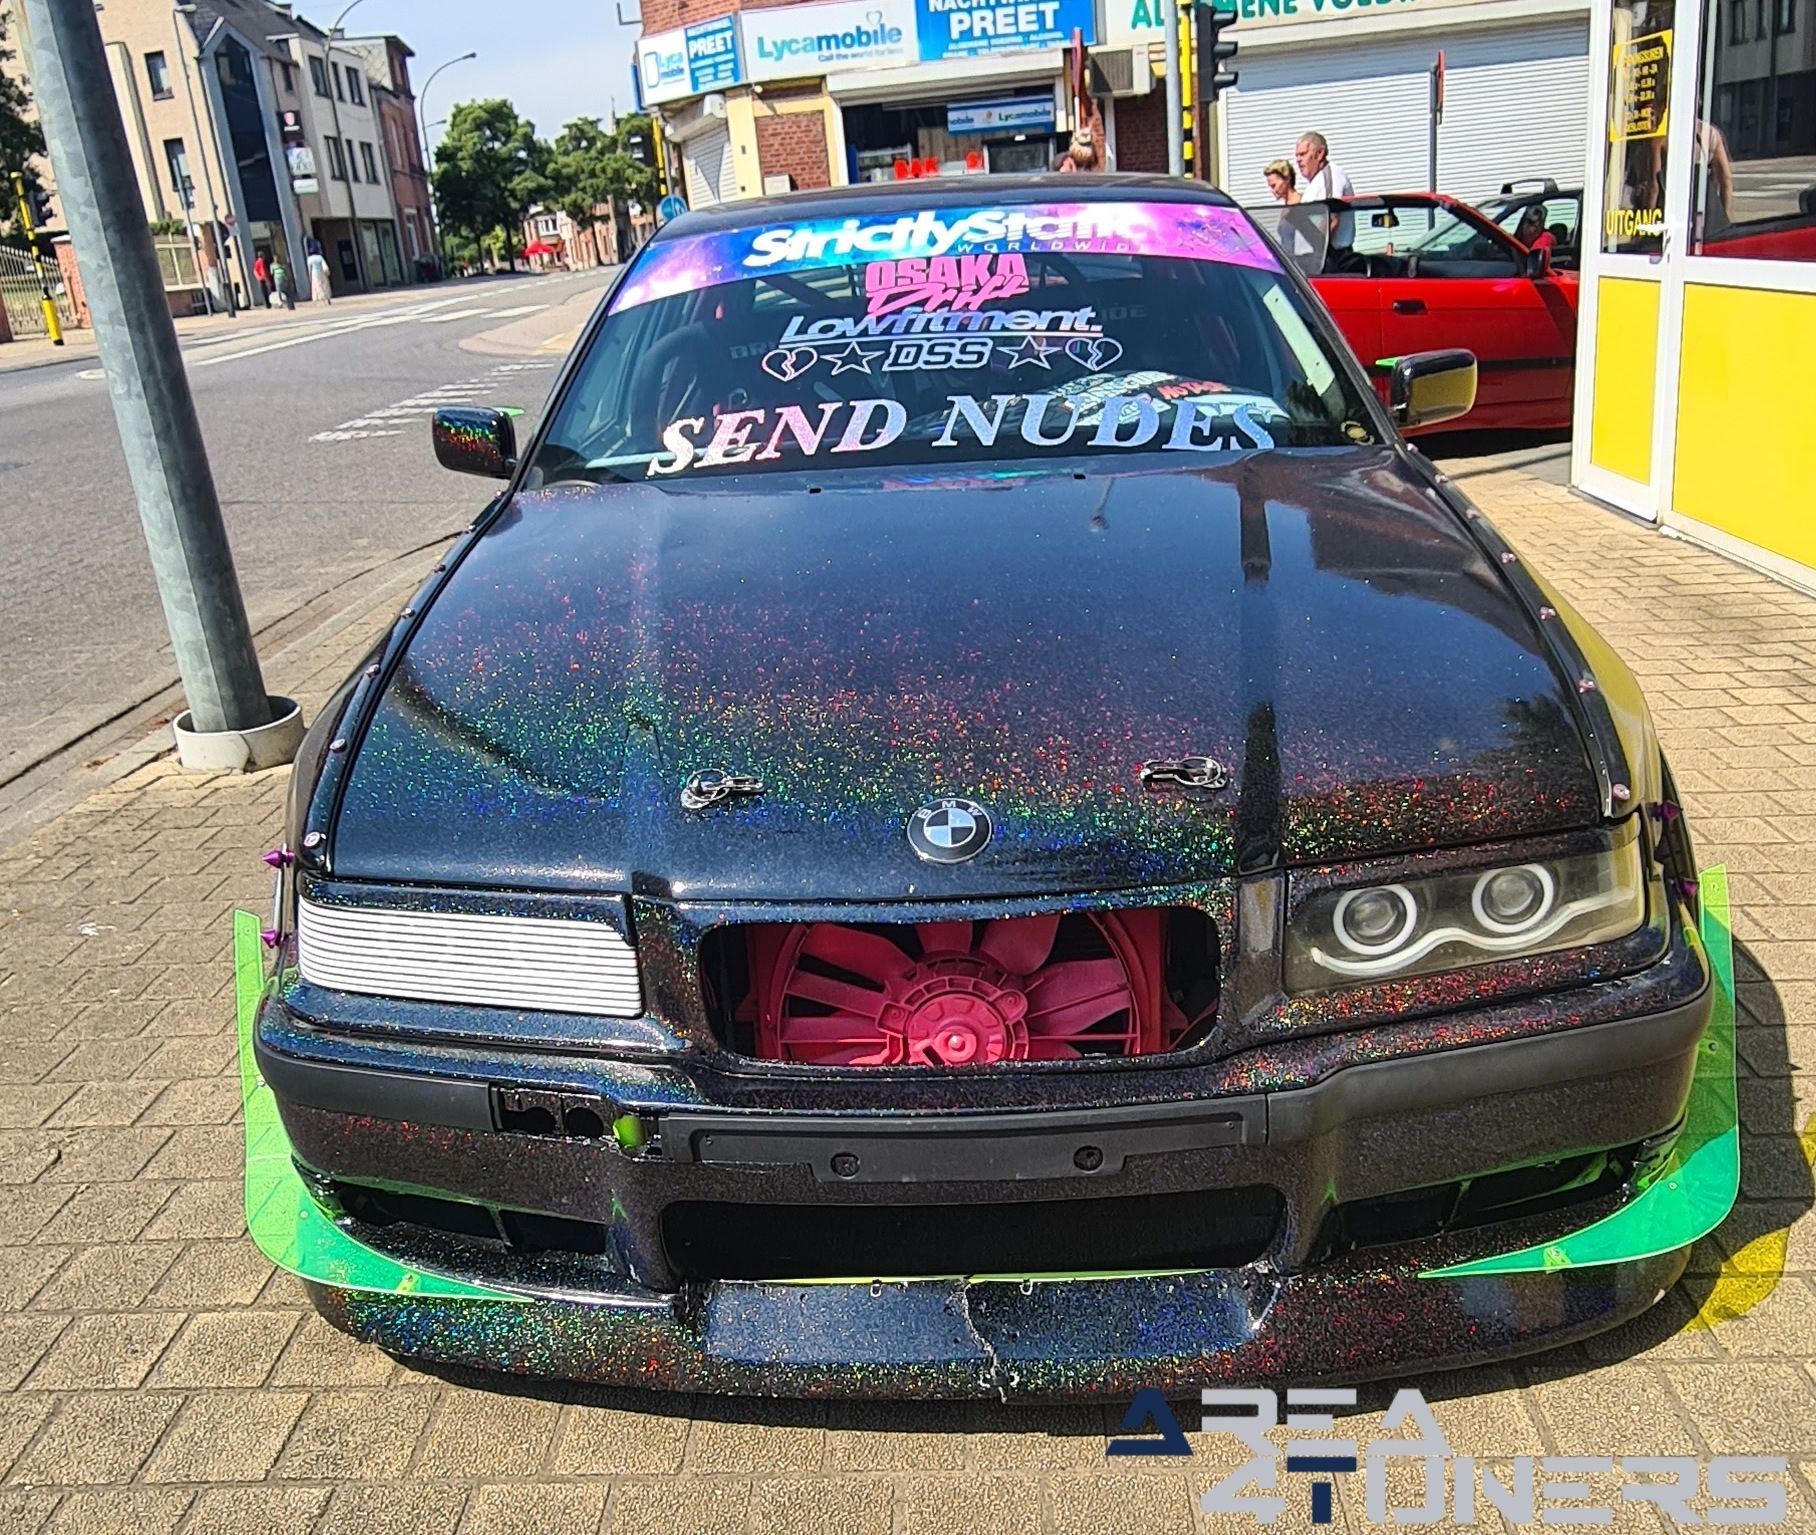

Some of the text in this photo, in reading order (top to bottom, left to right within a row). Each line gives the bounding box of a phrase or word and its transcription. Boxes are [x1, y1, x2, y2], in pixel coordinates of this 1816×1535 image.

[949, 1, 1060, 40] PREET
[1131, 0, 1298, 29] ALENE
[688, 30, 733, 58] PREET
[757, 22, 903, 62] Lycamobile
[1606, 208, 1663, 237] UITGANG
[865, 253, 1029, 293] OSAKA
[863, 274, 1029, 319] Drift
[881, 337, 993, 372] DSS
[644, 394, 1275, 480] SEND NUDES
[917, 800, 983, 819] BMW
